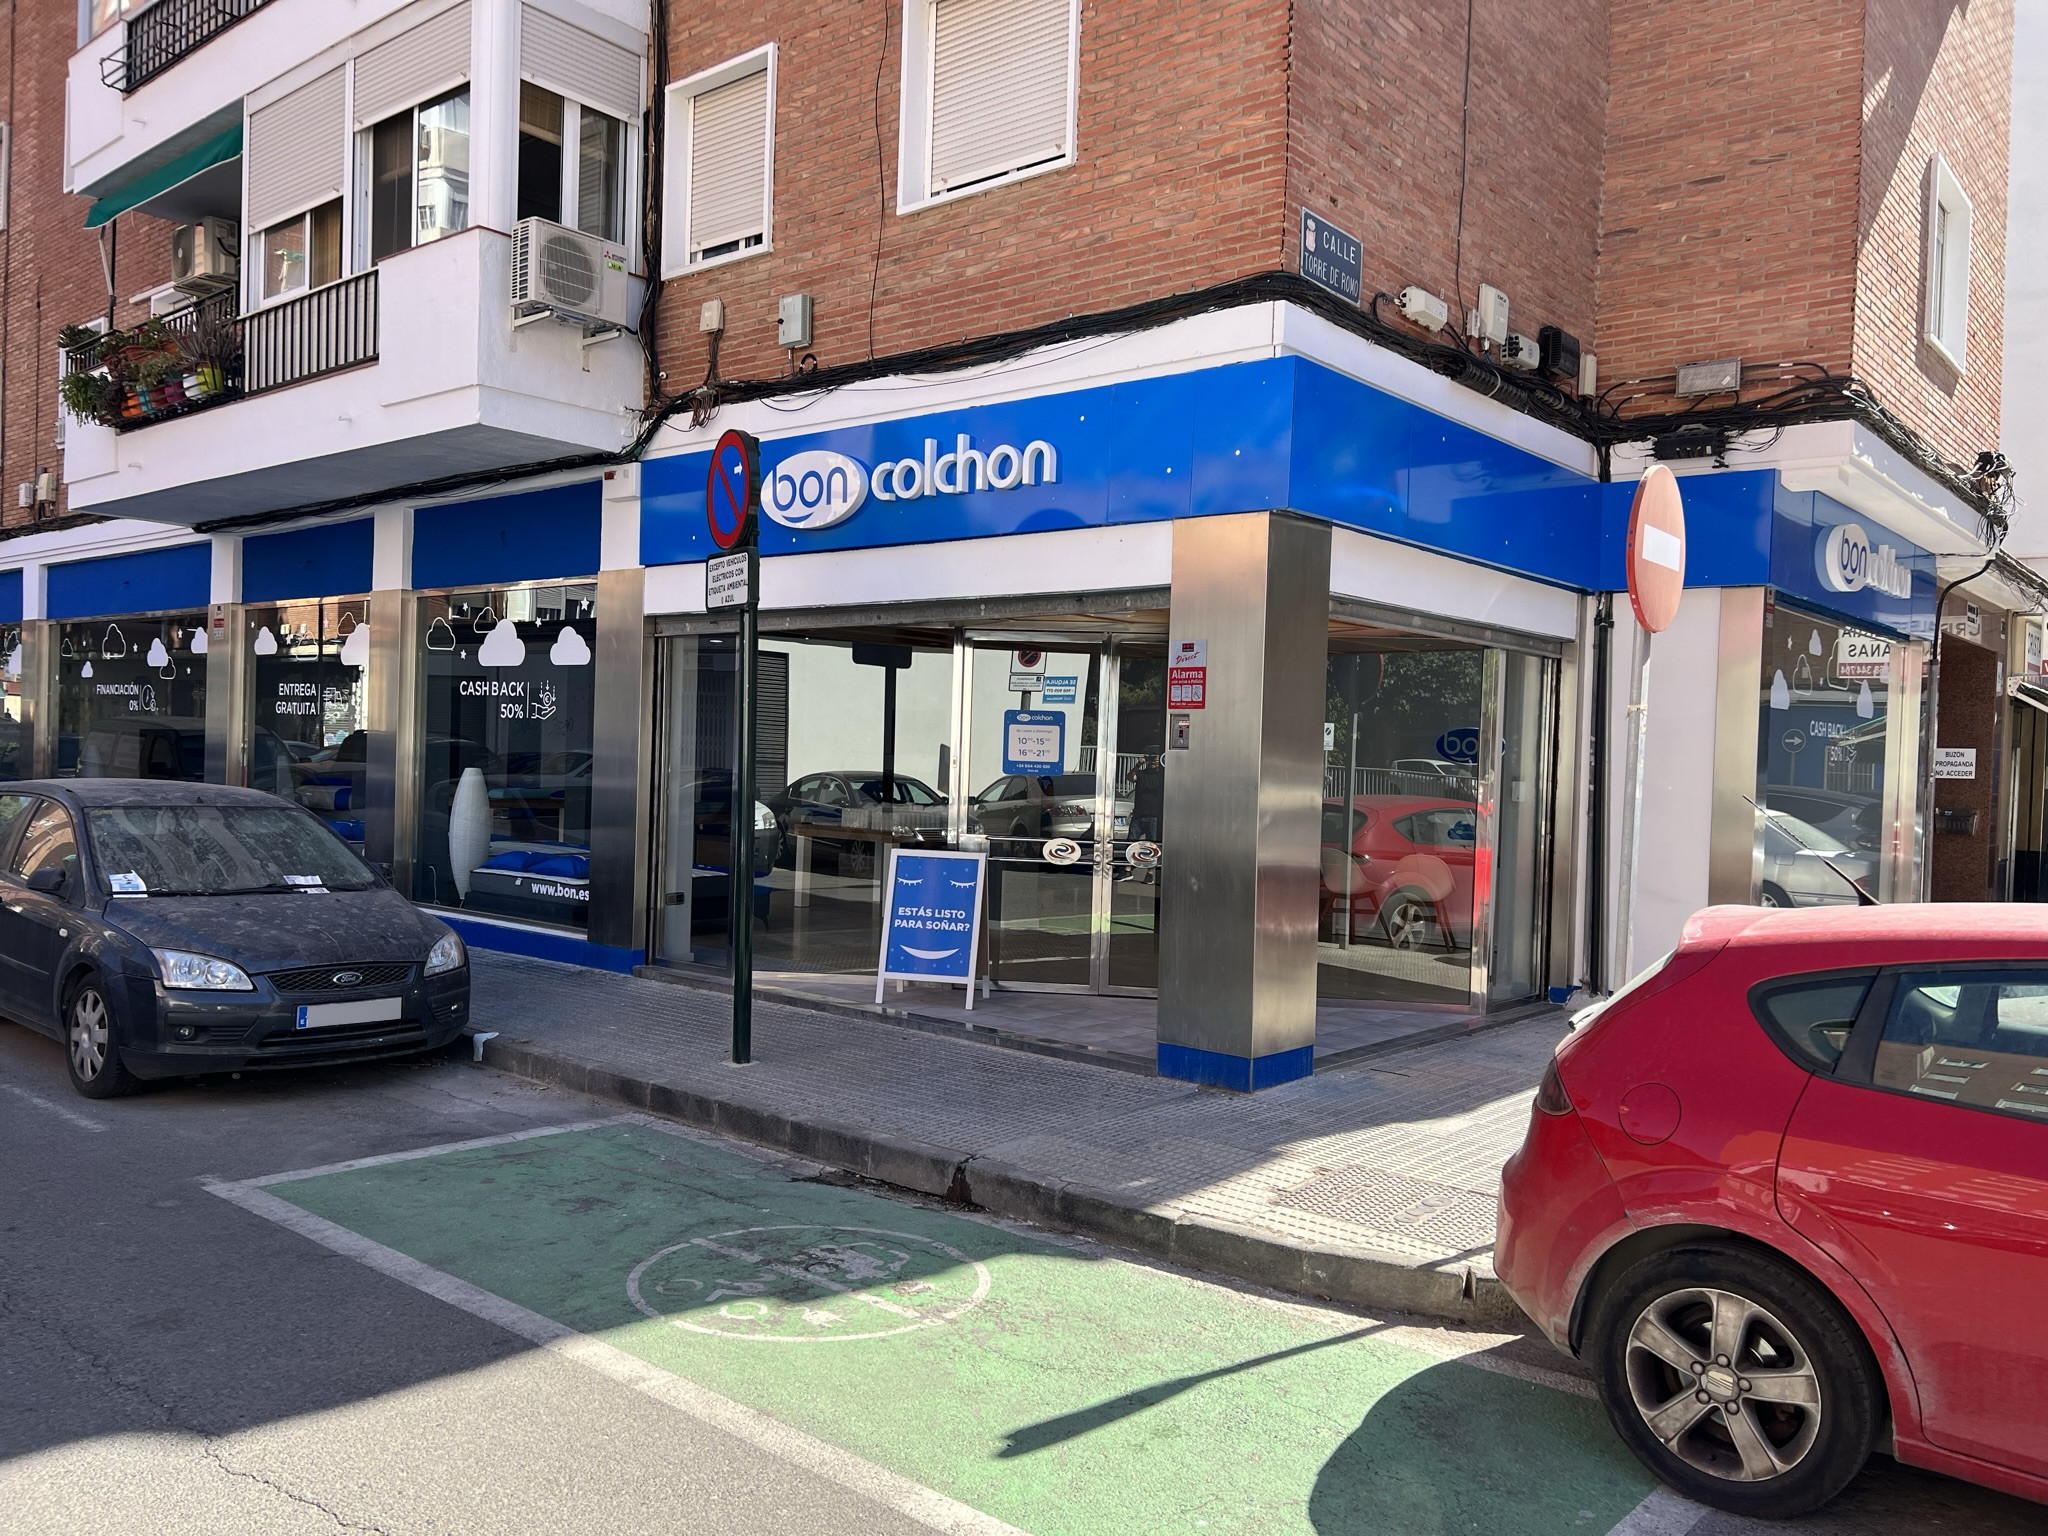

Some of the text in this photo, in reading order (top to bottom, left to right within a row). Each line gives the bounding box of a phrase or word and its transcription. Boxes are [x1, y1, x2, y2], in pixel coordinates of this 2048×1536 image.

[1323, 231, 1356, 265] CALLE
[1304, 251, 1359, 297] TORRE DE ROMO
[772, 434, 1056, 511] bon colchon
[1841, 528, 1867, 578] bon
[709, 560, 725, 572] EXCEPTO
[735, 567, 744, 577] CON
[709, 579, 748, 596] ETIQUETA AMBIENTAL
[725, 594, 734, 603] AZUL
[1171, 670, 1203, 679] Alarma
[96, 682, 139, 695] FINANCIACIÓN
[278, 683, 317, 697] ENTREGA
[459, 681, 525, 697] CASH BACK
[129, 700, 138, 711] 0%
[275, 701, 317, 715] GRATUITA
[500, 703, 524, 719] 50%
[1810, 720, 1827, 737] CASH
[1443, 732, 1479, 755] bo
[1935, 760, 1974, 768] PROPAGANDA
[531, 883, 590, 901] www.bon.es
[898, 906, 966, 919] ESTÁS LISTO
[894, 919, 970, 932] PARA SOÑAR?
[340, 974, 357, 983] Ford
